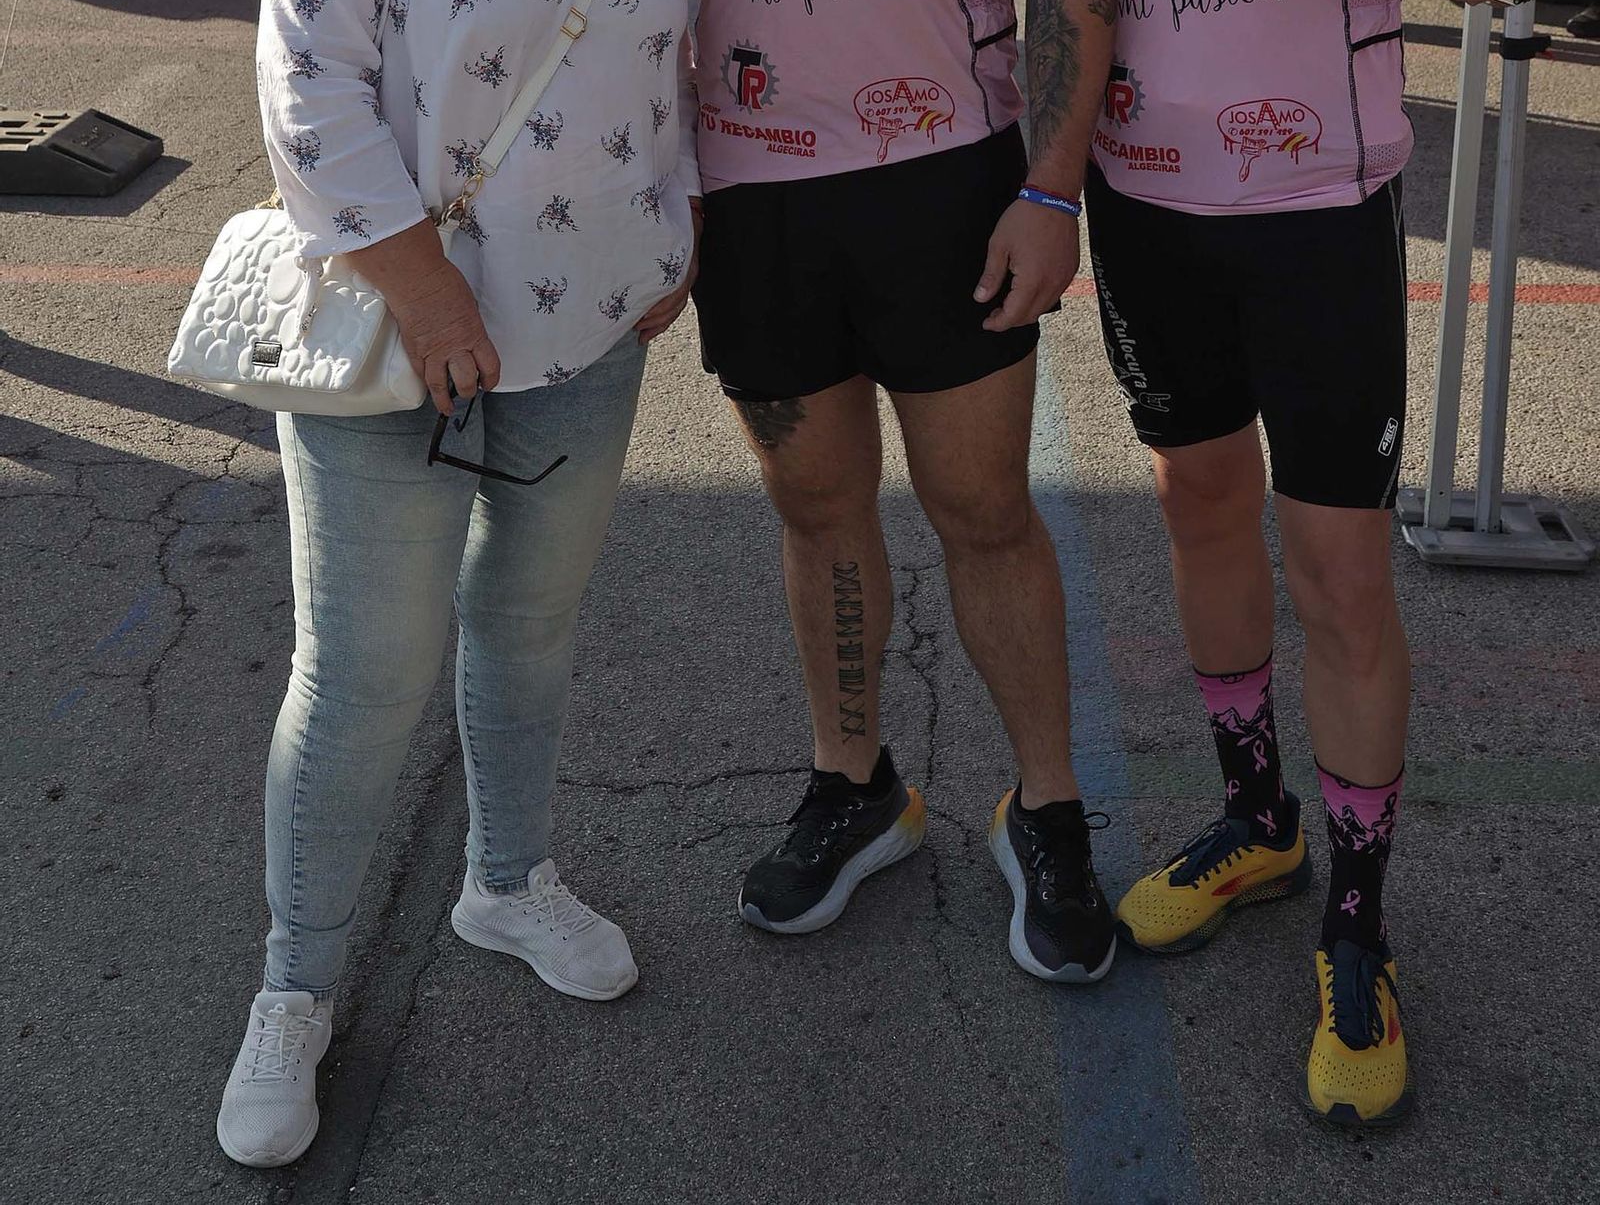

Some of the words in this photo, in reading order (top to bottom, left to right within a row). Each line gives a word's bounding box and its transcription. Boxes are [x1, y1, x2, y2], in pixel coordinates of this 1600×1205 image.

[865, 81, 940, 107] JOSAMO
[1228, 102, 1306, 130] JOSAMO
[720, 119, 817, 147] RECAMBIO
[1094, 129, 1181, 164] RECAMBIO
[766, 143, 816, 158] ALGECIRAS
[1127, 162, 1181, 173] ALGECIRAS
